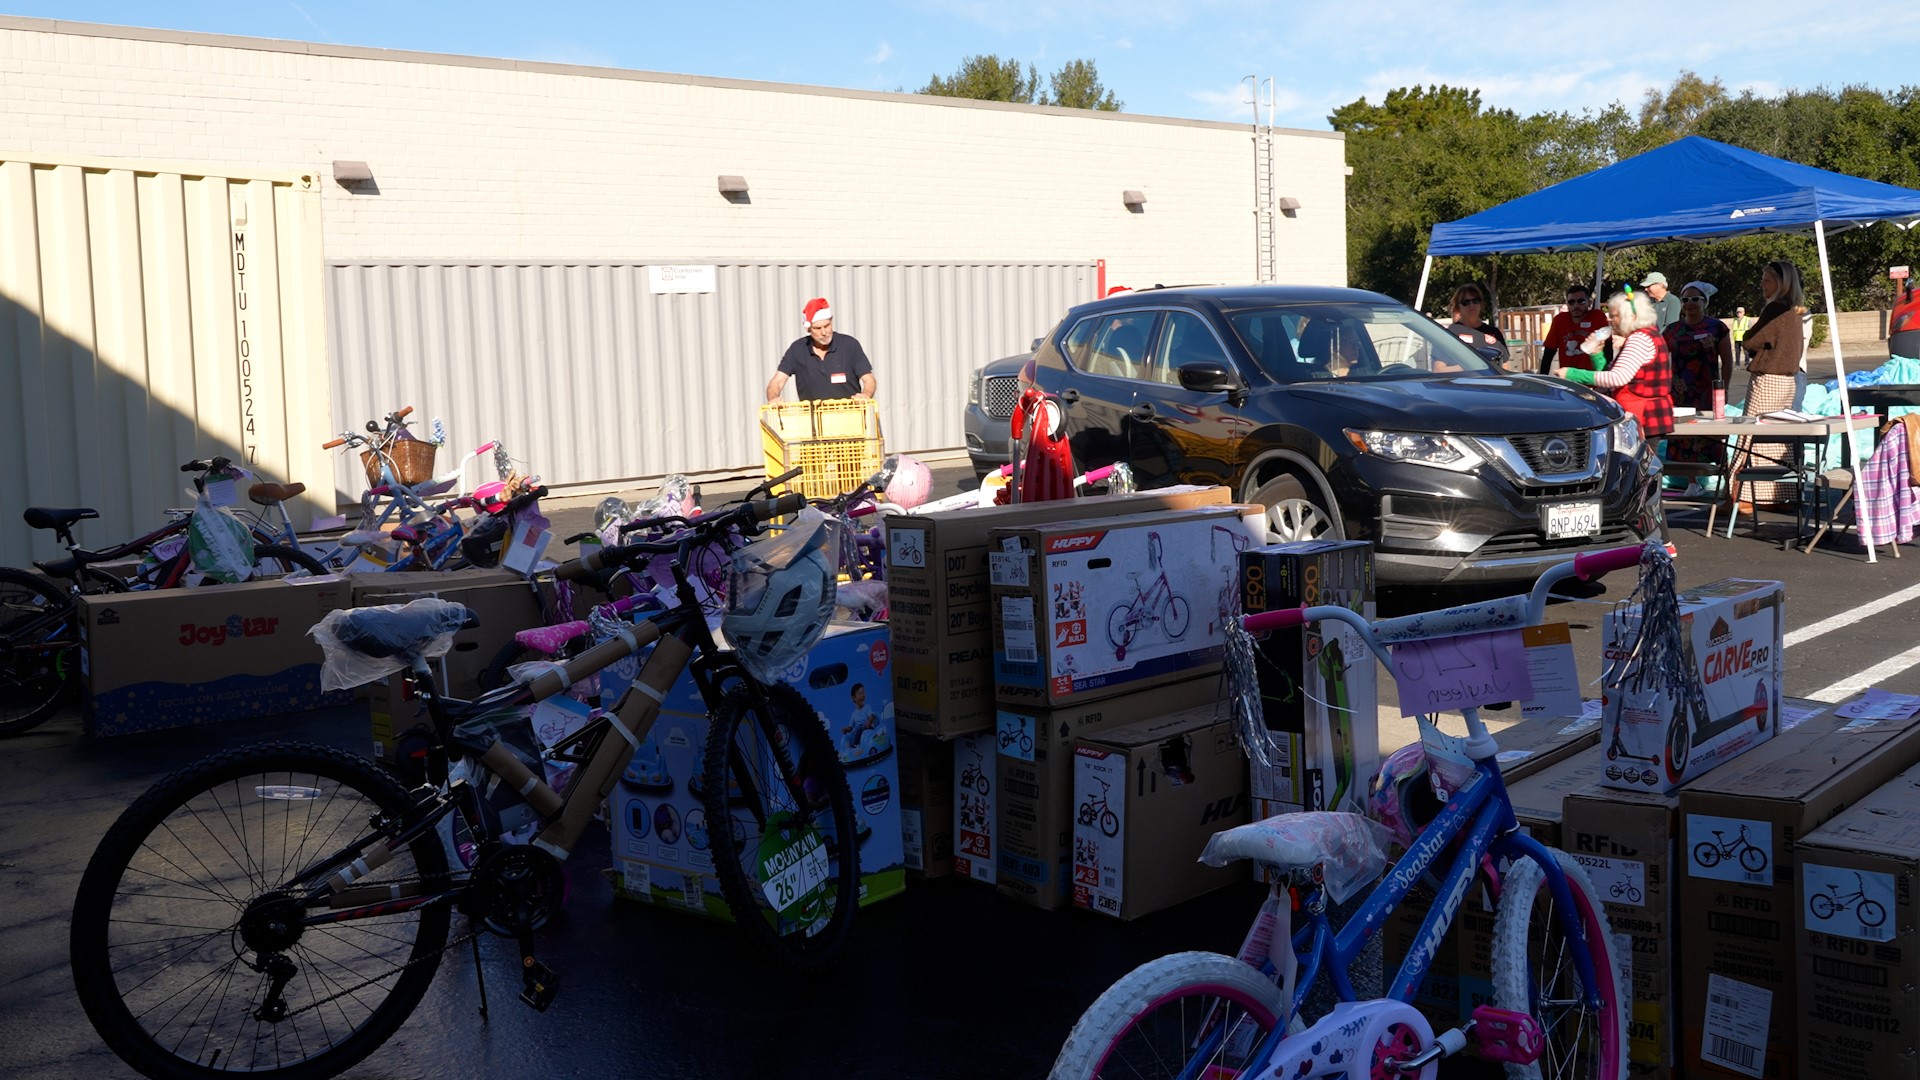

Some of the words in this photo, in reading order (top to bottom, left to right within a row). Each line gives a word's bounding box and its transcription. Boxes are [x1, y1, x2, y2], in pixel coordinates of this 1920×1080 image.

[1551, 515, 1596, 533] 8NPJ694
[1052, 535, 1096, 549] HUFFY
[949, 556, 966, 571] D07
[1247, 565, 1264, 609] E90
[1305, 564, 1319, 603] 90
[1444, 607, 1481, 616] HUFFY
[178, 614, 279, 646] JoyStar
[1704, 639, 1753, 685] CARVE
[1750, 646, 1769, 667] PRO
[1074, 681, 1088, 690] SEA
[1089, 677, 1106, 688] STAR
[158, 696, 194, 709] FOCUS
[196, 694, 214, 704] ON
[216, 690, 240, 702] KIDS
[243, 684, 289, 698] CYCLING
[1085, 713, 1102, 724] RFID
[1076, 747, 1104, 758] HUFFY
[1016, 767, 1035, 781] RFID
[764, 832, 818, 877] MOUNTAIN
[1394, 831, 1446, 889] Seastar
[1022, 862, 1040, 877] 403
[775, 873, 796, 905] 26"
[1425, 853, 1476, 960] HUFFY
[1733, 895, 1771, 913] RFID
[1828, 936, 1868, 955] RFID
[1636, 991, 1662, 1001] FLAT
[1816, 1004, 1900, 1034] 552309112
